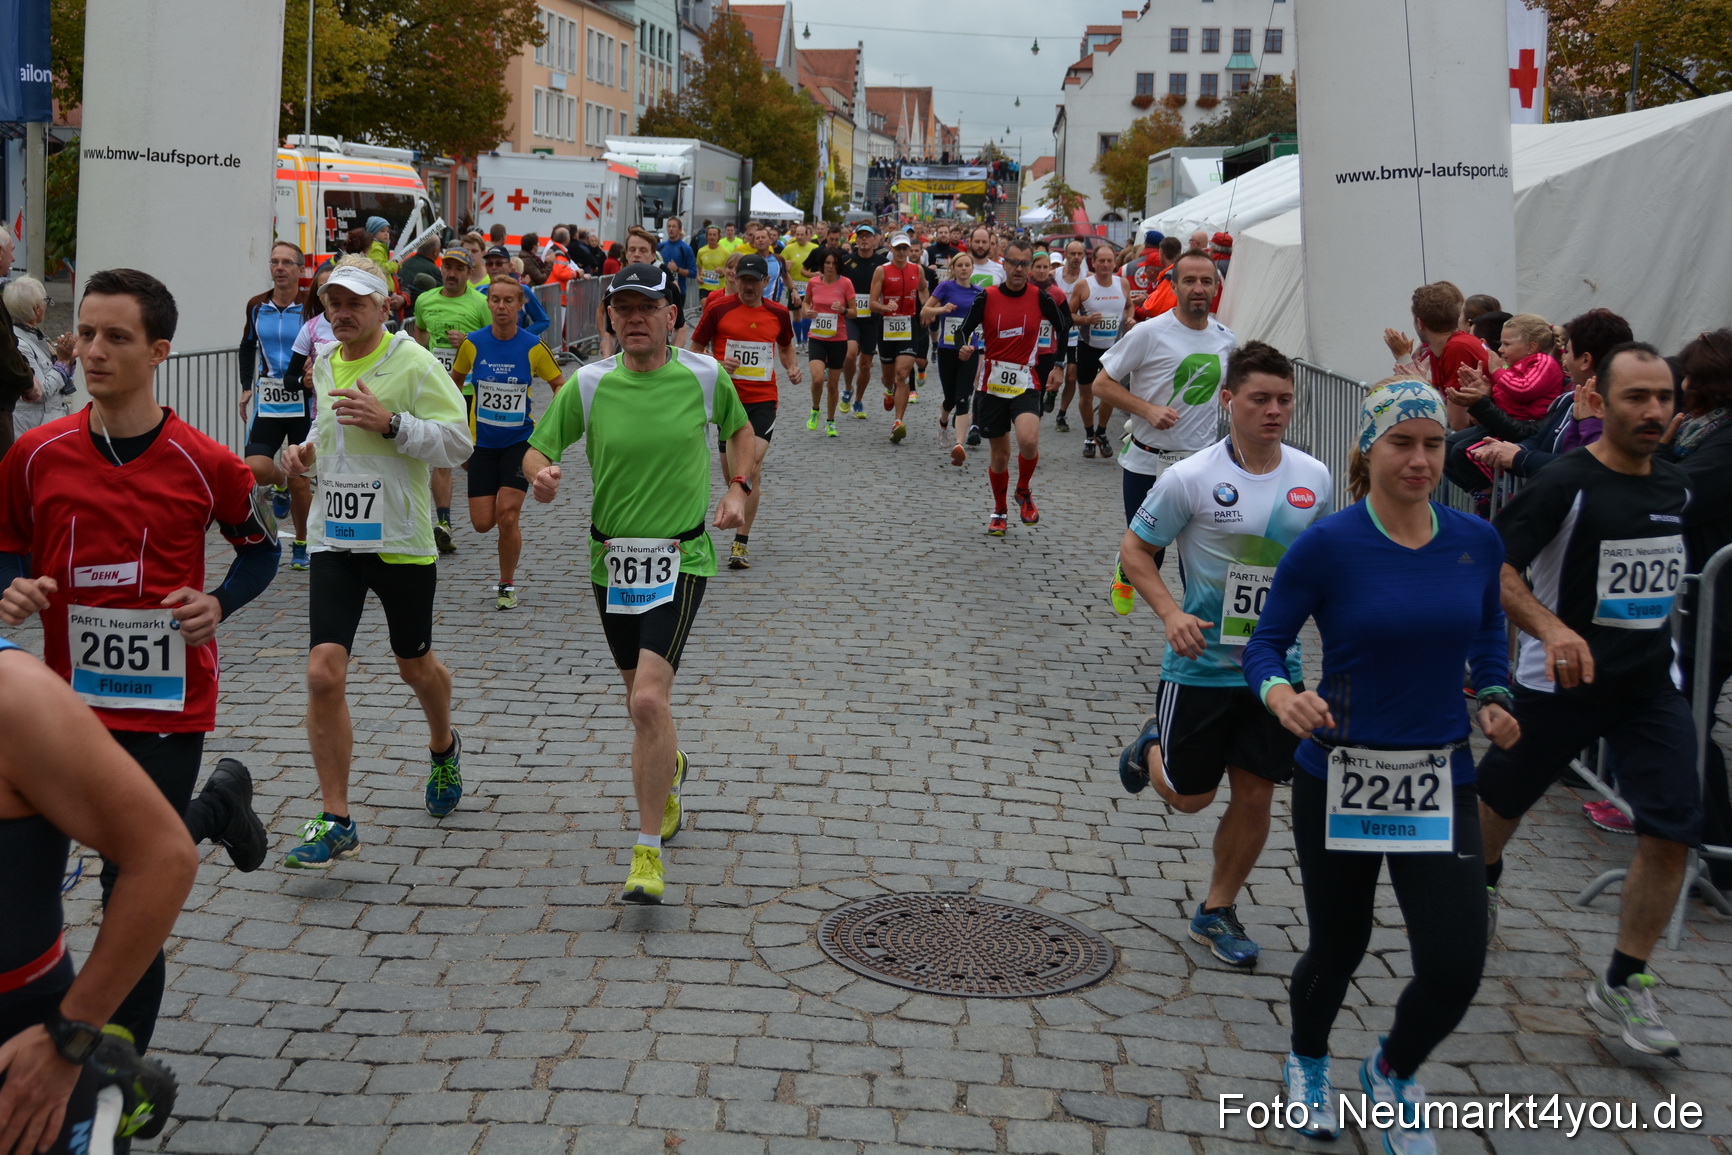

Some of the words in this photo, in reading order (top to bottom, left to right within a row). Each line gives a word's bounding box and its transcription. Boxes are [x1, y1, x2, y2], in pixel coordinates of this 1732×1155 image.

[83, 145, 241, 168] www.bmw-laufsport.de
[1335, 161, 1508, 184] www.bmw-laufsport.de
[533, 189, 574, 198] Bayerisches
[926, 183, 957, 191] START
[532, 206, 552, 214] Kreuz
[815, 319, 832, 330] 506
[889, 321, 906, 332] 503
[733, 350, 759, 366] 505
[1000, 371, 1017, 385] 98
[263, 387, 300, 402] 3058
[482, 392, 522, 410] 2337
[335, 481, 369, 489] Neumarkt
[325, 490, 376, 520] 2097
[1214, 510, 1243, 518] PARTL
[334, 525, 355, 538] Erich
[627, 545, 665, 553] Neumarkt
[1603, 548, 1634, 557] PARTL
[1635, 546, 1675, 555] Neumarkt
[90, 570, 120, 581] DEHN
[609, 556, 672, 585] 2613
[1229, 571, 1260, 582] PARTL
[1608, 558, 1680, 594] 2026
[620, 592, 656, 604] Thomas
[1627, 602, 1663, 617] Eyuep
[71, 614, 107, 628] PARTL
[109, 619, 165, 630] Neumarkt
[80, 631, 170, 672] 2651
[100, 678, 153, 695] Florian
[1331, 755, 1372, 769] PARTL
[1375, 759, 1430, 771] Neumarkt
[1341, 771, 1440, 811] 2242
[1361, 819, 1417, 837] Verena
